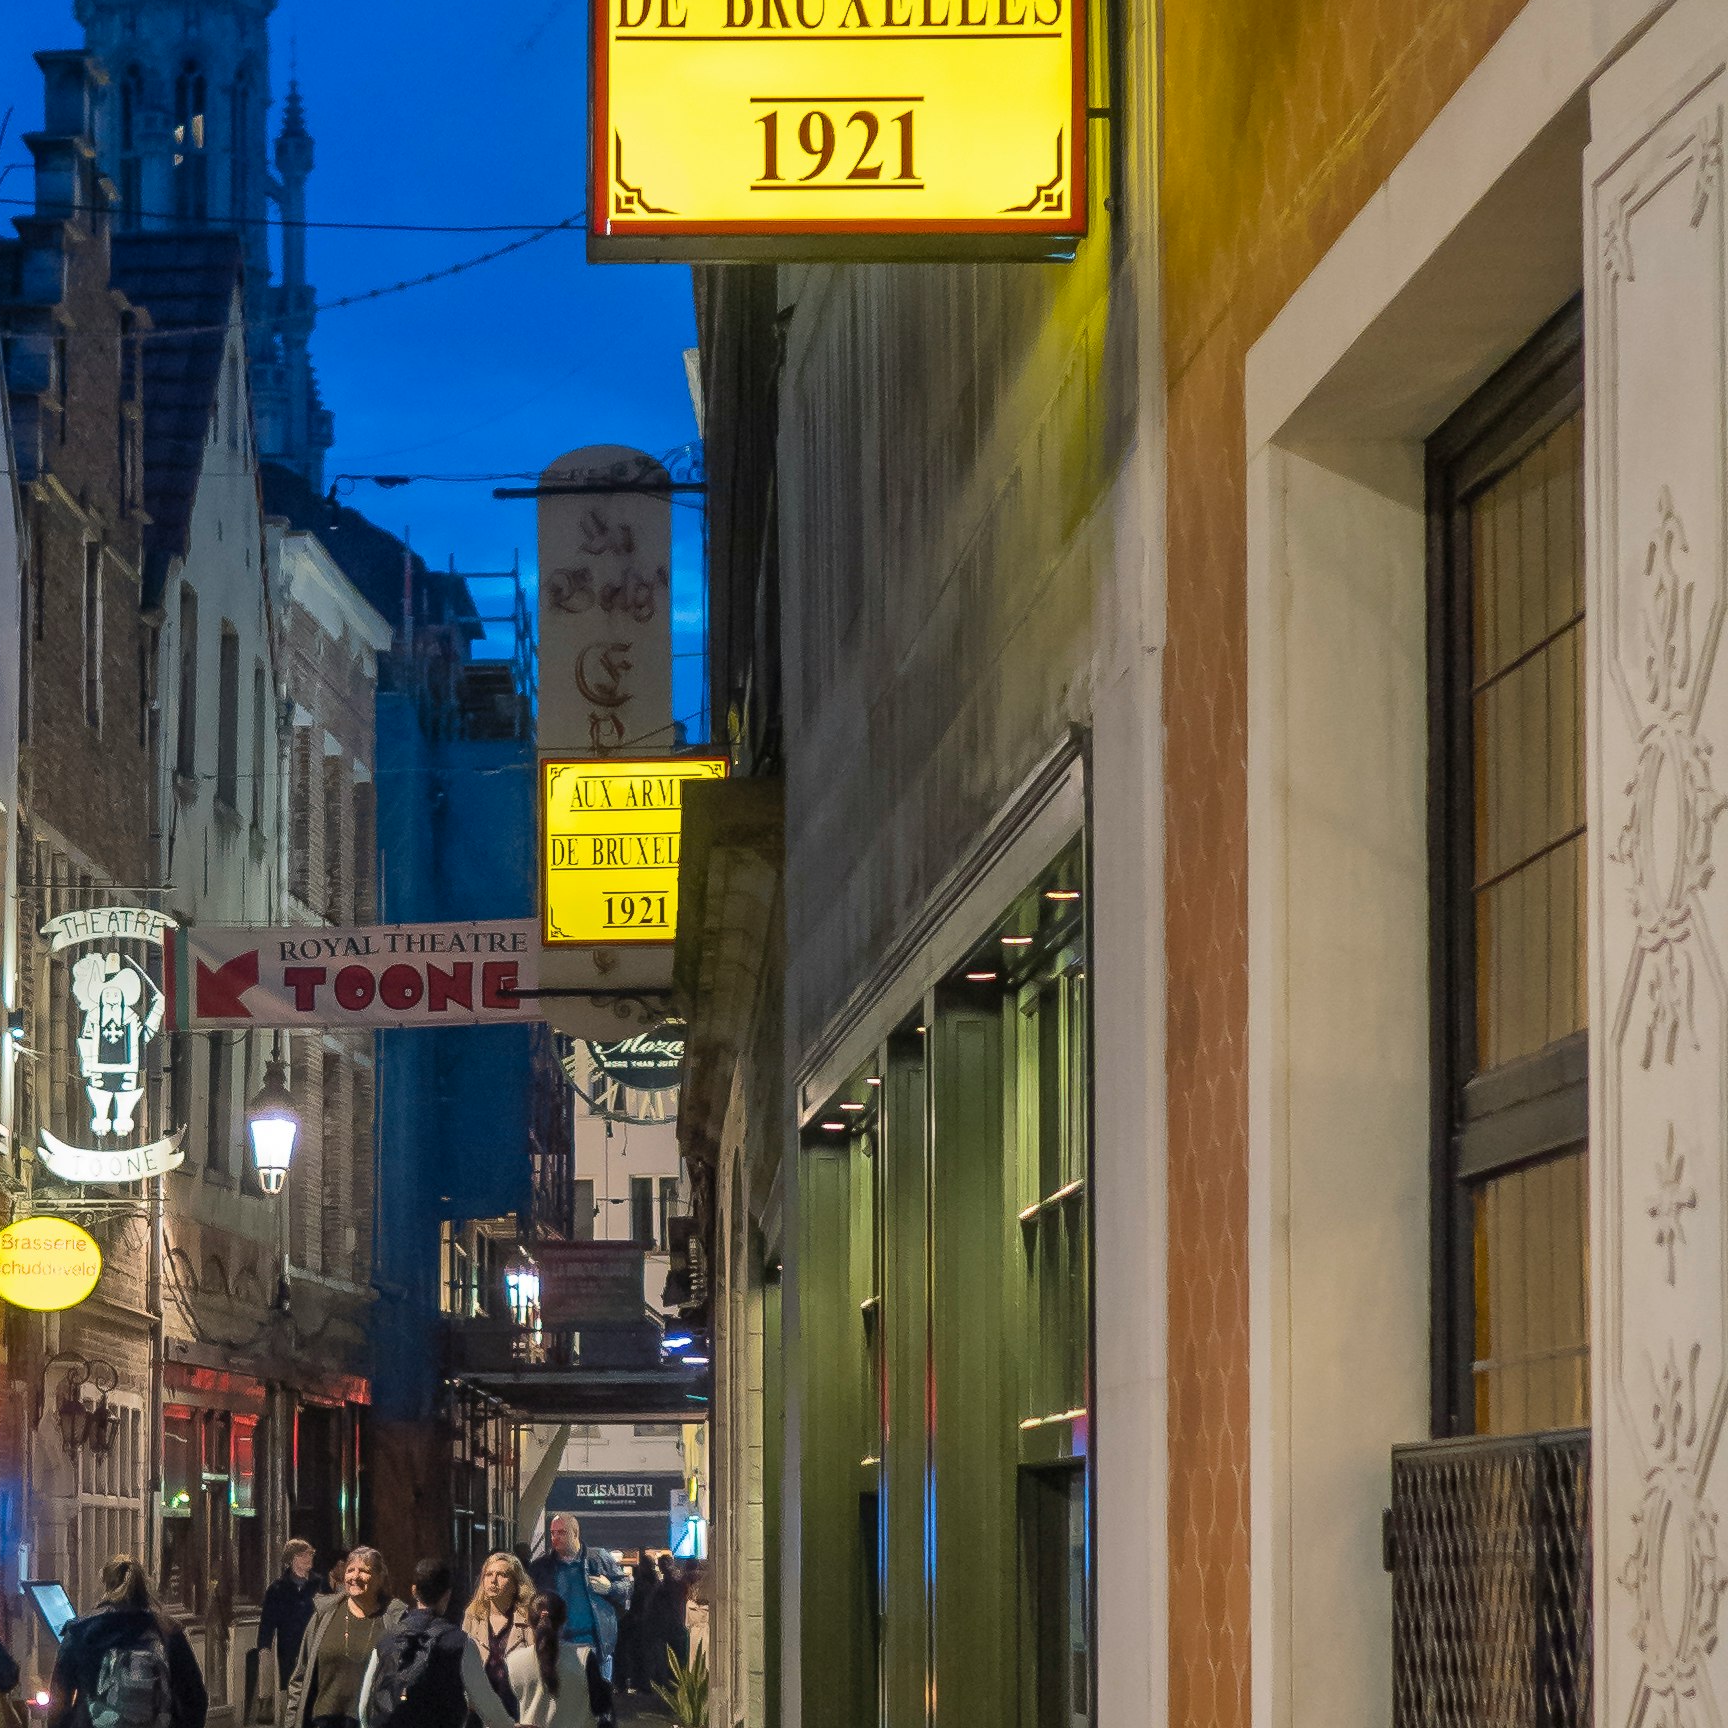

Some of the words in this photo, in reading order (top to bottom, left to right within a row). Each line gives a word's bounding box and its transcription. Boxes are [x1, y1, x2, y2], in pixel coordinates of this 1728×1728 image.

[754, 109, 922, 182] 1921
[571, 779, 613, 808] AUX
[551, 838, 579, 866] DE
[59, 910, 167, 939] THEATRE
[604, 896, 667, 925] 1921
[278, 934, 380, 962] ROYAL
[384, 931, 528, 953] THEATRE
[284, 960, 521, 1012] TOONE
[73, 1148, 158, 1176] TOONE
[1, 1233, 87, 1252] Brasserie
[576, 1484, 654, 1497] ELISABETH
